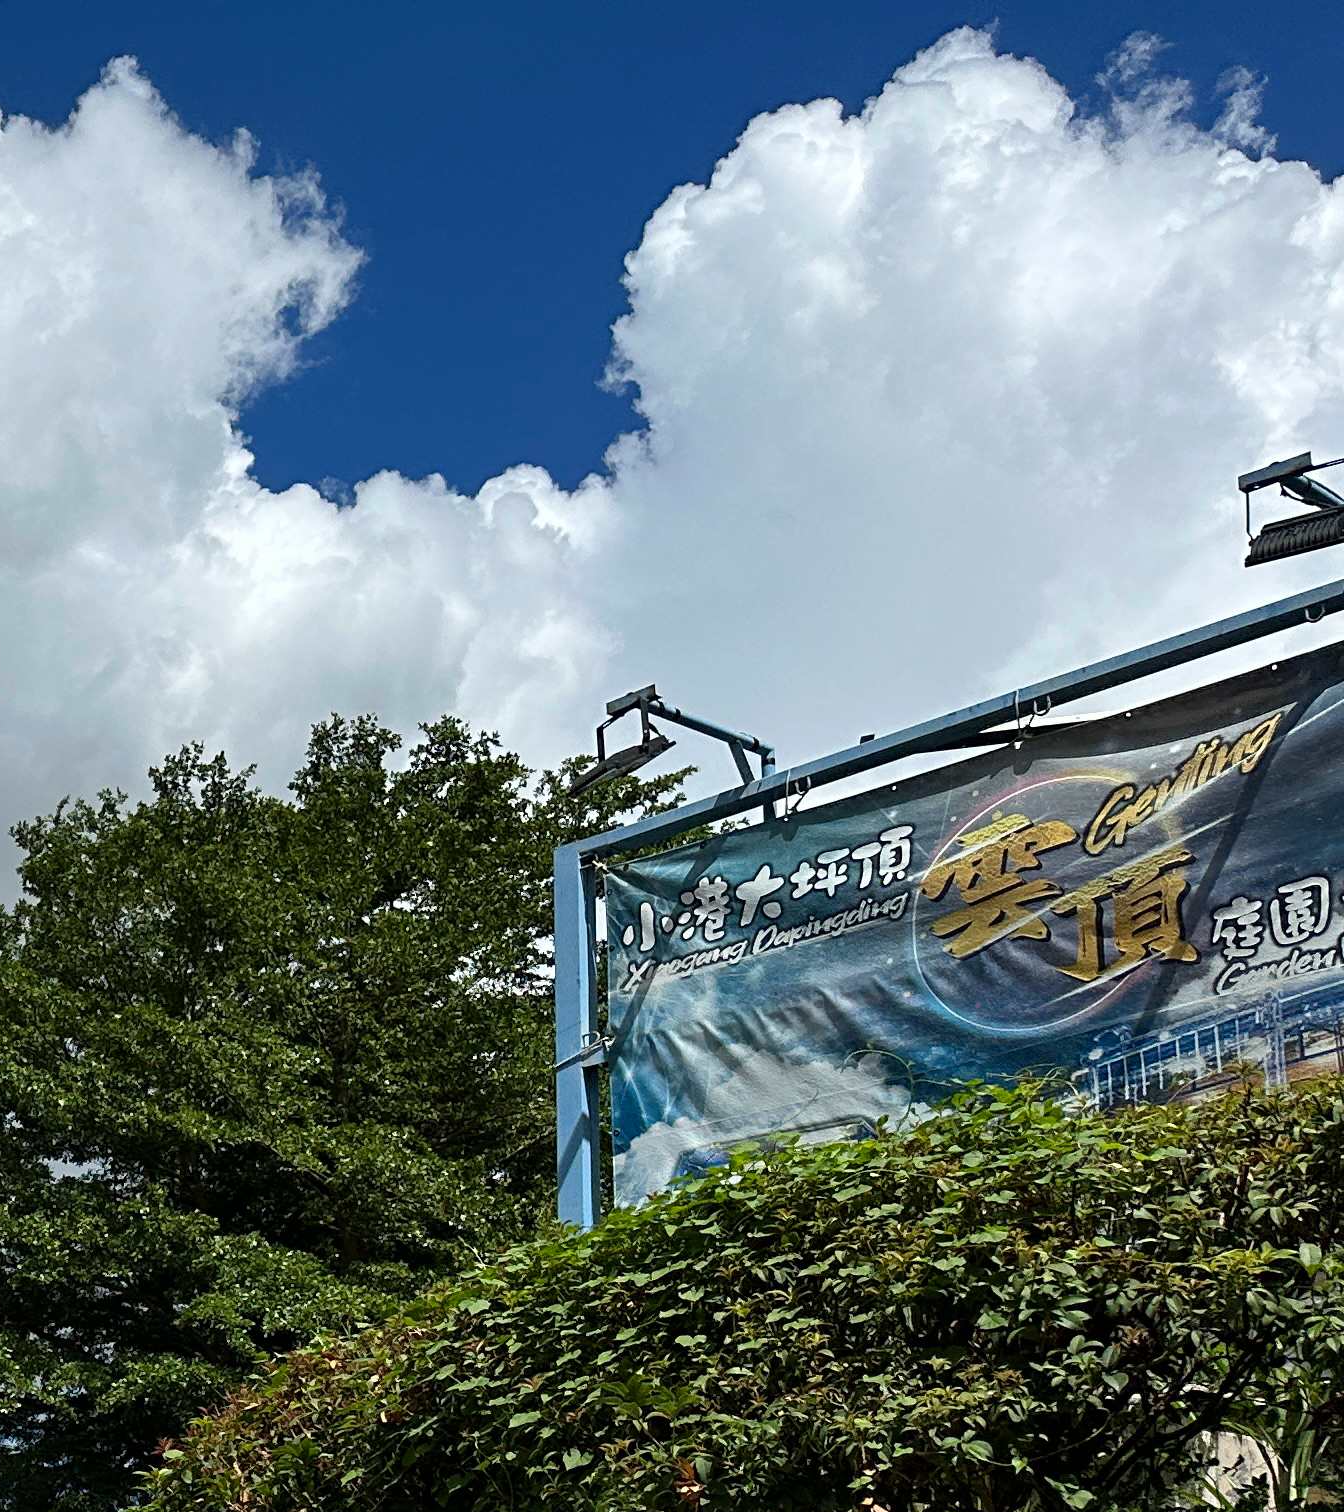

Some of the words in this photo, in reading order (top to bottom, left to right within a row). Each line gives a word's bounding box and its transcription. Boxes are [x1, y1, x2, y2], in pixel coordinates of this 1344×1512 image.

[1082, 712, 1285, 857] Genting
[622, 825, 914, 952] 小港大坪頂
[752, 892, 910, 956] Dapingding
[921, 813, 1201, 983] 雲頂
[1213, 876, 1330, 960] 庭園
[1216, 948, 1337, 996] Garden
